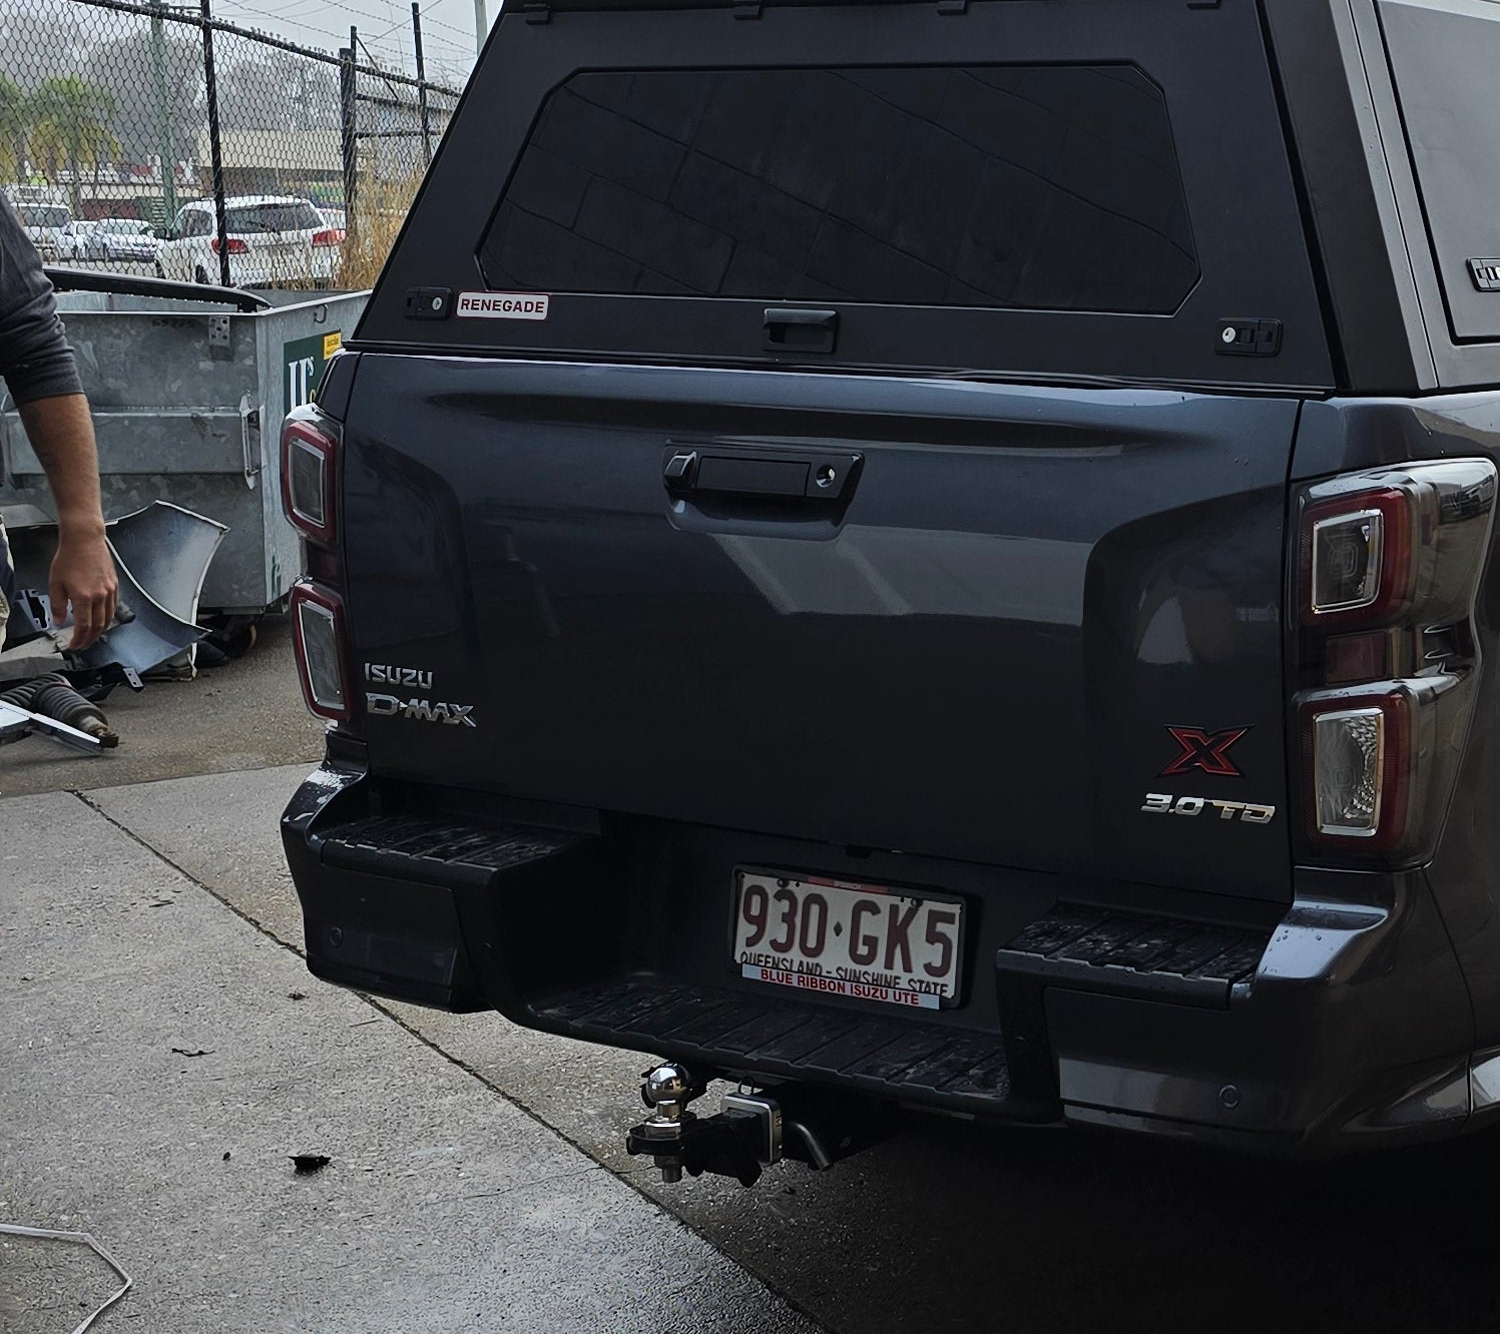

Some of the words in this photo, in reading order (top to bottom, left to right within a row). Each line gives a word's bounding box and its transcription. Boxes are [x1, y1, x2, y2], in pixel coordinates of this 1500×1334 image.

[460, 298, 545, 313] RENEGADE
[364, 662, 433, 689] ISUZU
[365, 692, 477, 727] D-MAX
[1156, 724, 1254, 778] X
[1141, 793, 1204, 816] 3.0
[1211, 799, 1276, 824] TD
[740, 951, 822, 977] QUEENSLAND
[836, 966, 902, 989] SUNSHINE
[907, 978, 949, 997] STATE
[760, 969, 793, 985] BLUE
[797, 975, 846, 994] RIBBON
[850, 982, 889, 1001] ISUZU
[892, 991, 920, 1005] UTE
